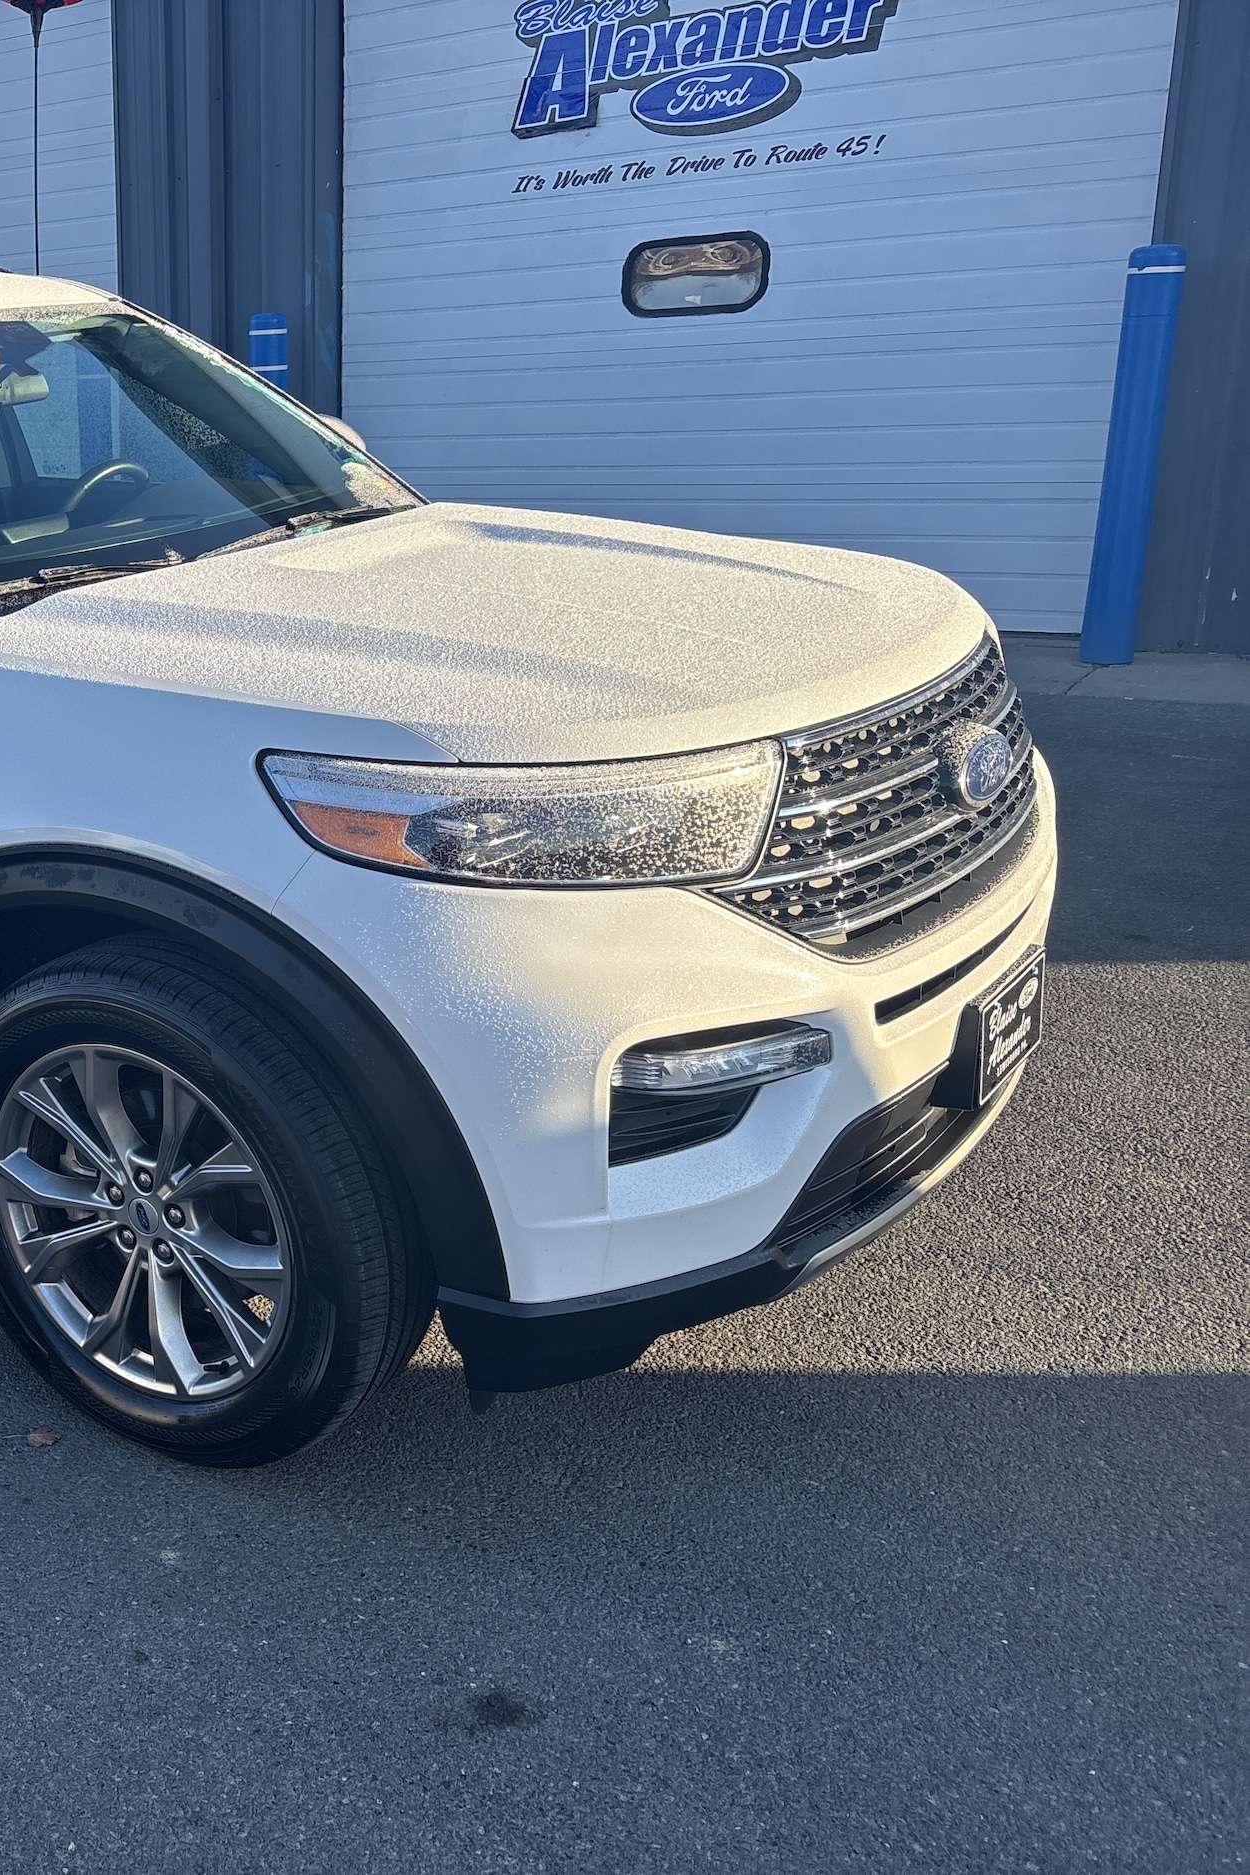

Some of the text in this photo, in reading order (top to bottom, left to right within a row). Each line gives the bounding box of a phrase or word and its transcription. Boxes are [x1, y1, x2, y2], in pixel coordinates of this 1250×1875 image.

[515, 0, 887, 128] Alexander
[666, 72, 754, 116] Ford
[511, 174, 546, 194] It's
[552, 164, 614, 190] Worth
[620, 160, 656, 182] The
[665, 155, 726, 176] Drive
[732, 148, 757, 169] To
[764, 142, 829, 166] Route
[986, 1012, 1032, 1076] Alexander
[988, 1001, 1018, 1042] Blaise
